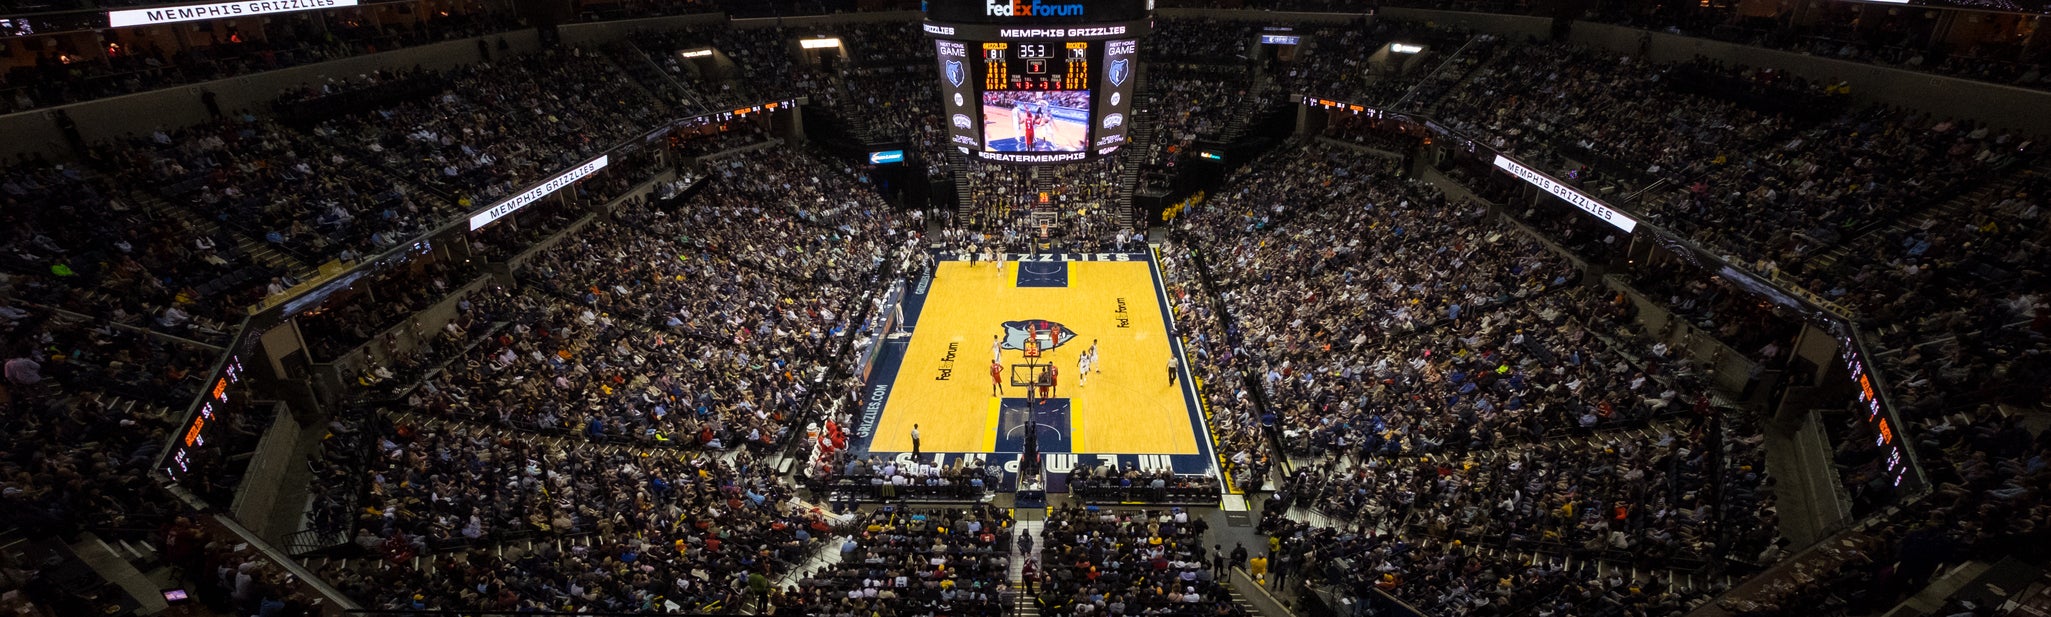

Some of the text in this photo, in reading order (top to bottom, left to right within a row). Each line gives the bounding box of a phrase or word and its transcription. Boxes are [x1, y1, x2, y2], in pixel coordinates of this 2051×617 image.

[147, 0, 334, 21] MEMPHIS GRIZZLIES
[986, 0, 1083, 16] FedExForum
[1000, 26, 1126, 38] MEMPHIS GRIZZLIES
[940, 46, 966, 57] GAME
[991, 50, 1002, 59] 81
[1020, 45, 1044, 57] 35.3
[1073, 49, 1083, 58] 79
[1108, 46, 1135, 56] GAME
[979, 152, 1085, 162] #GREATERMEMPHIS
[490, 163, 595, 220] MEMPHIS GRIZZLIES
[1508, 162, 1613, 220] MEMPHIS GRIZZLIES
[856, 384, 888, 438] GRIZZLIES.COM
